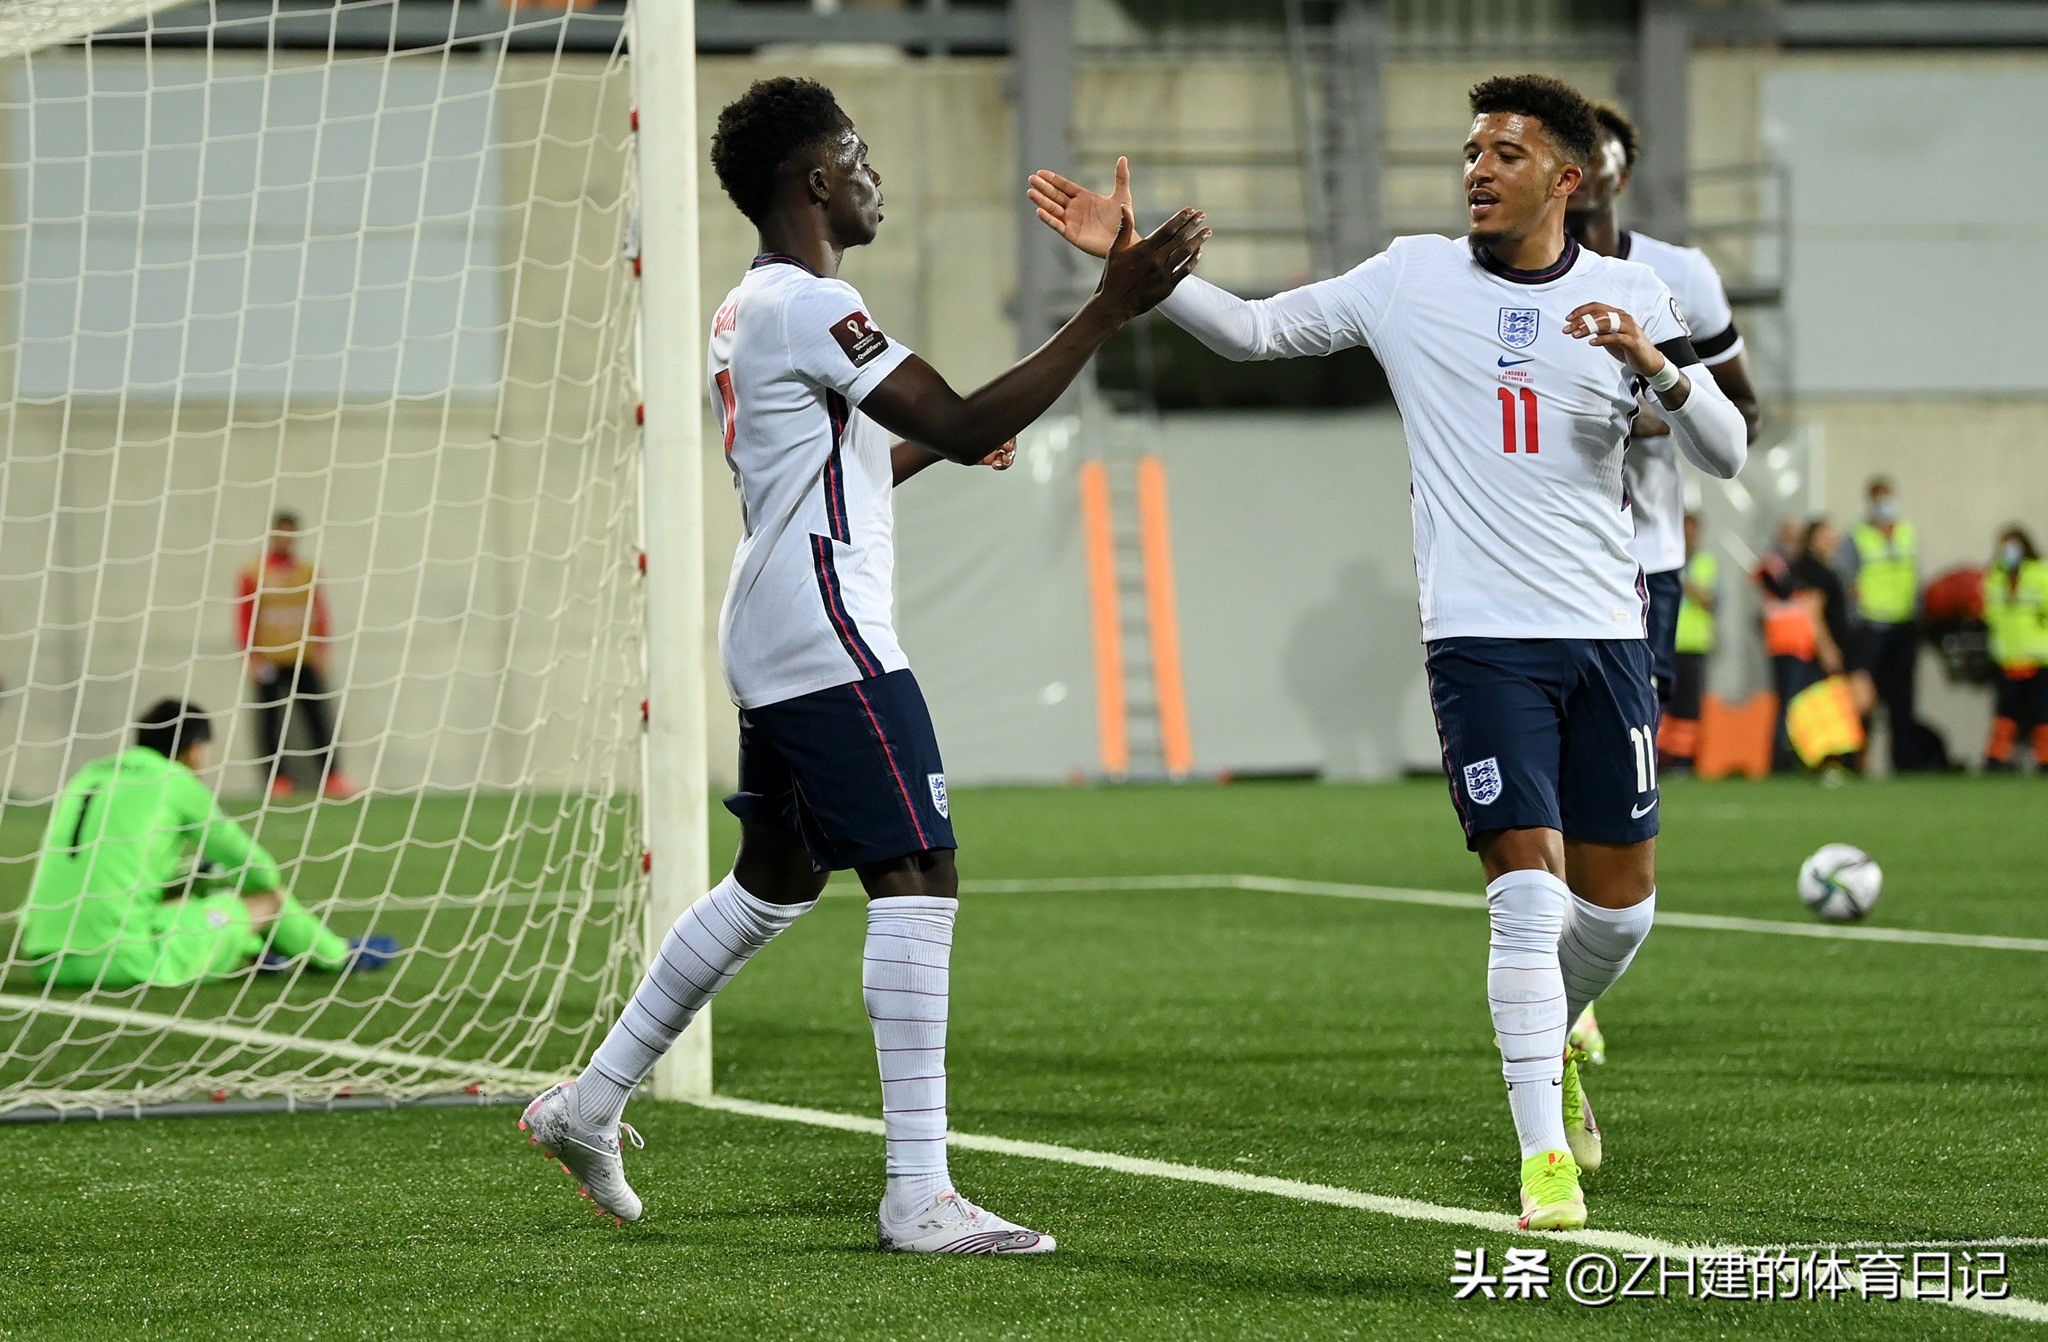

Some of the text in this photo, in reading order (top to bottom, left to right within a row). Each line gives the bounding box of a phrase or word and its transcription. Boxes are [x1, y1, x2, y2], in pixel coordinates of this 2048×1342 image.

[1497, 387, 1539, 453] 11
[1629, 724, 1656, 794] 11
[70, 783, 101, 860] 1
